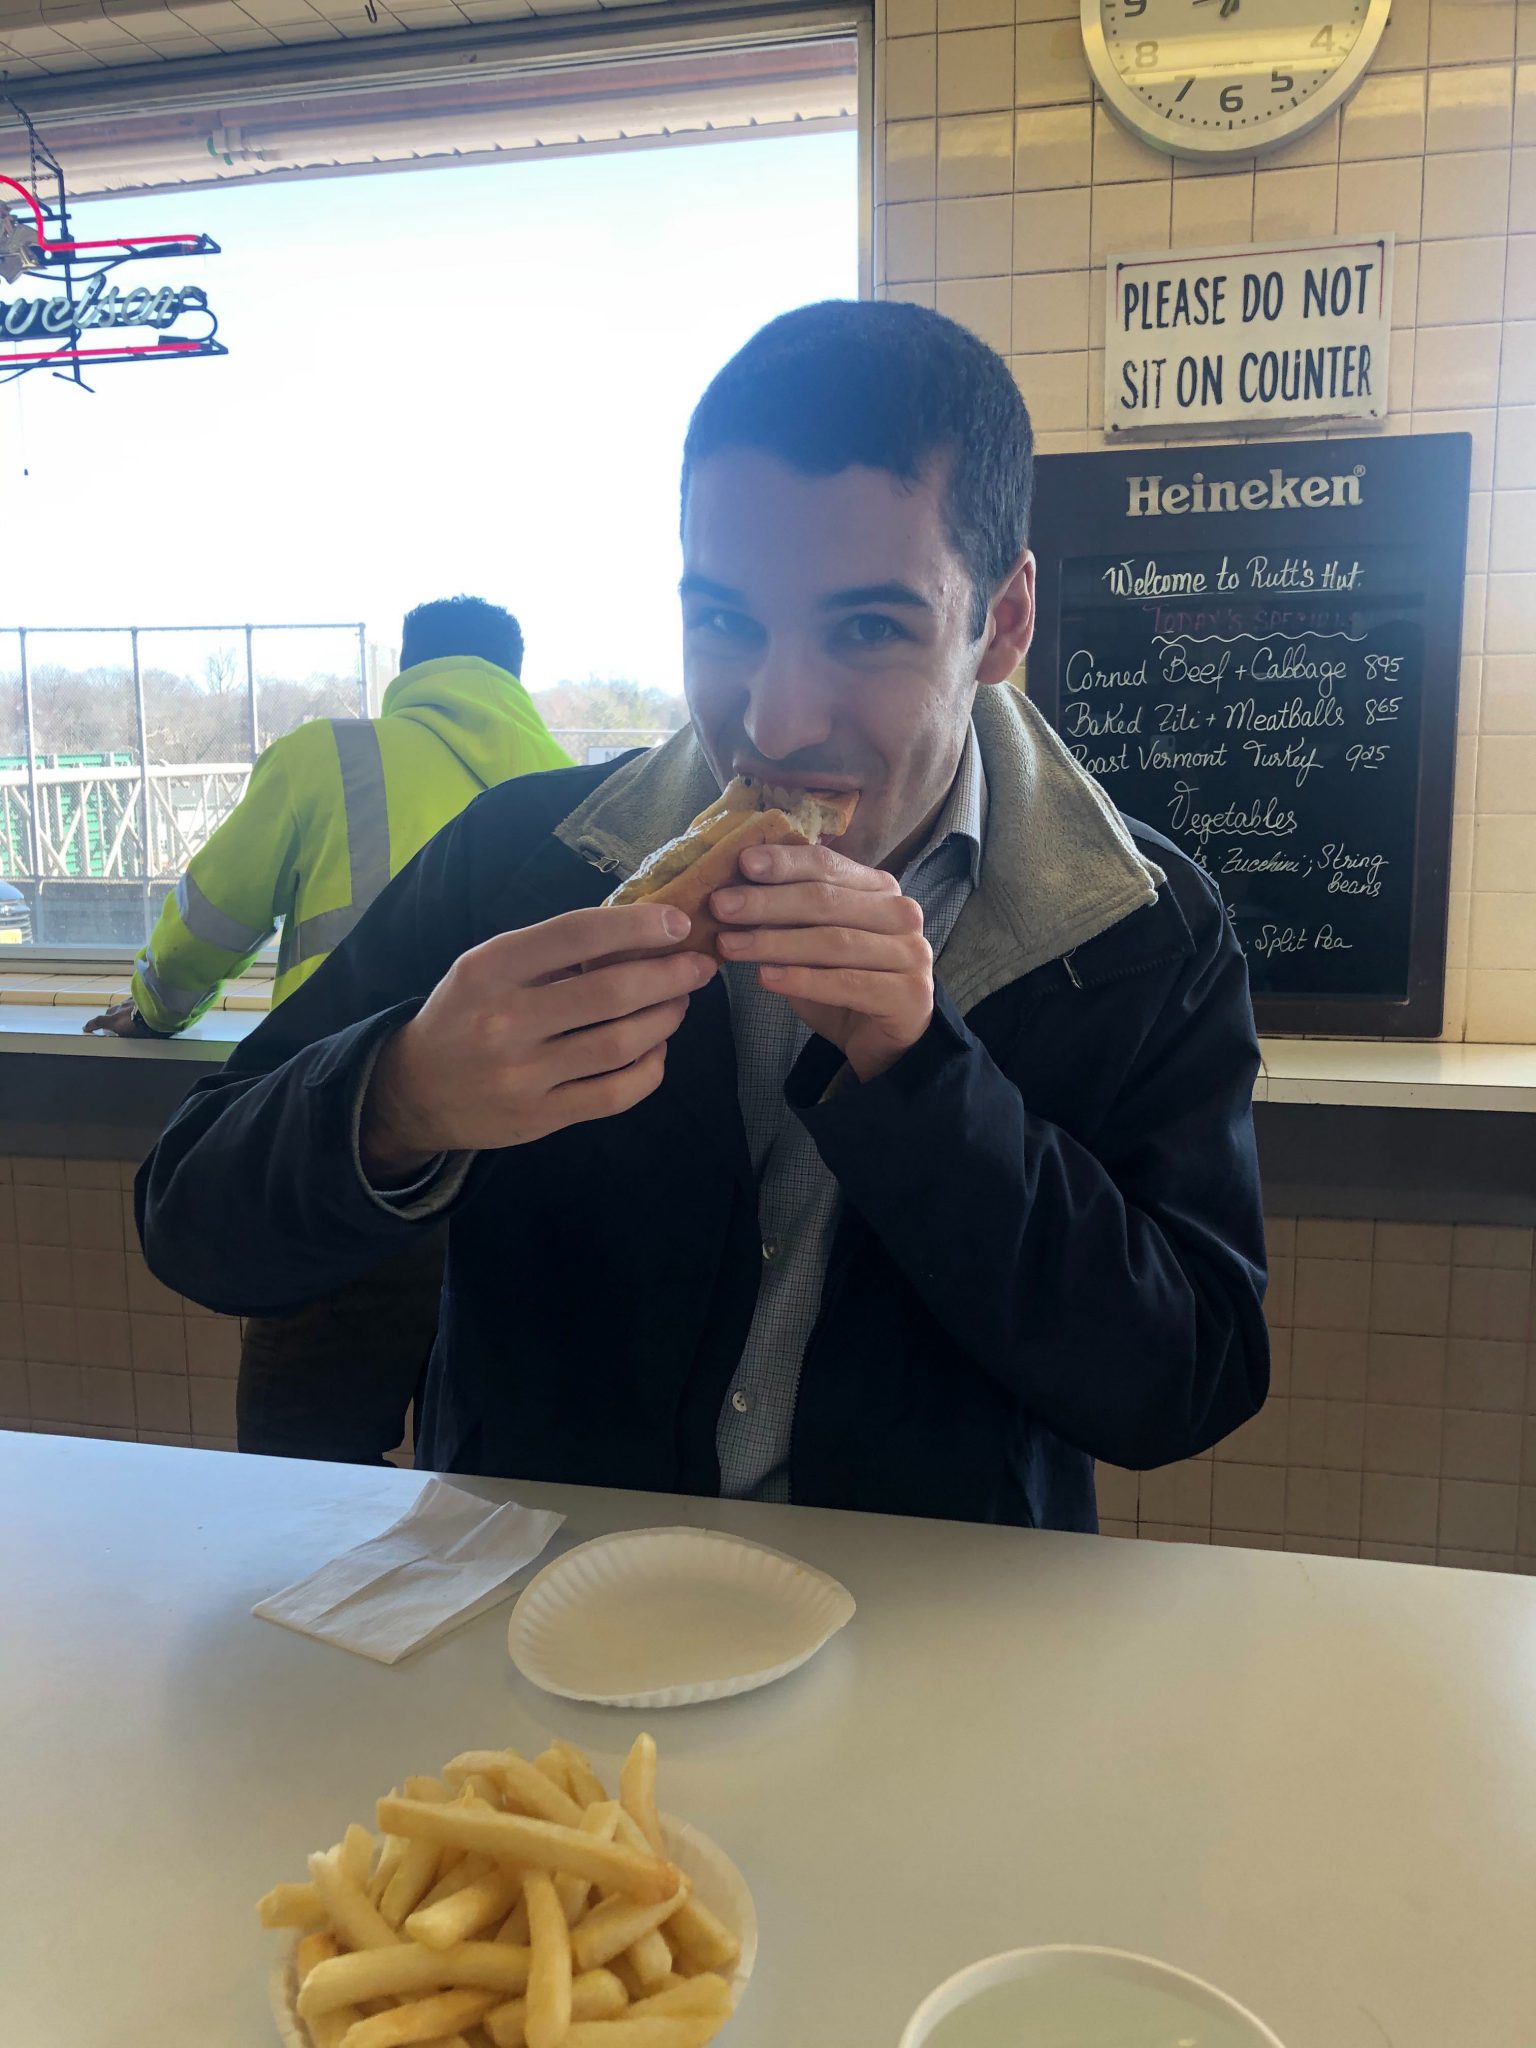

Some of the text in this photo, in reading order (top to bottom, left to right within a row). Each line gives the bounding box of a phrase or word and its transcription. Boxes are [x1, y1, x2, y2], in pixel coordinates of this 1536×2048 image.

[1135, 41, 1158, 68] 8
[1310, 24, 1334, 51] 4
[1174, 75, 1196, 102] 7
[1219, 85, 1243, 113] 6
[1271, 66, 1293, 93] 5
[1124, 263, 1374, 331] PLEASE DO NOT
[1120, 344, 1373, 409] SIT ON COUNTER
[1125, 468, 1364, 517] Heineken
[1102, 559, 1207, 596] Welcome
[1216, 556, 1240, 591] to
[1246, 556, 1315, 588] Rutt's
[1066, 650, 1147, 692] Corned
[1159, 644, 1231, 694] Beef
[1251, 643, 1347, 698] Cabbage
[1065, 702, 1142, 737] Baked
[1154, 704, 1200, 732] Ziti
[1224, 697, 1345, 731] Meatballs
[1138, 740, 1228, 770] Vermont
[1243, 737, 1324, 787] Turkey
[1167, 780, 1298, 844] Vegetables
[1317, 843, 1390, 884] String
[1255, 923, 1353, 958] Split Pea
